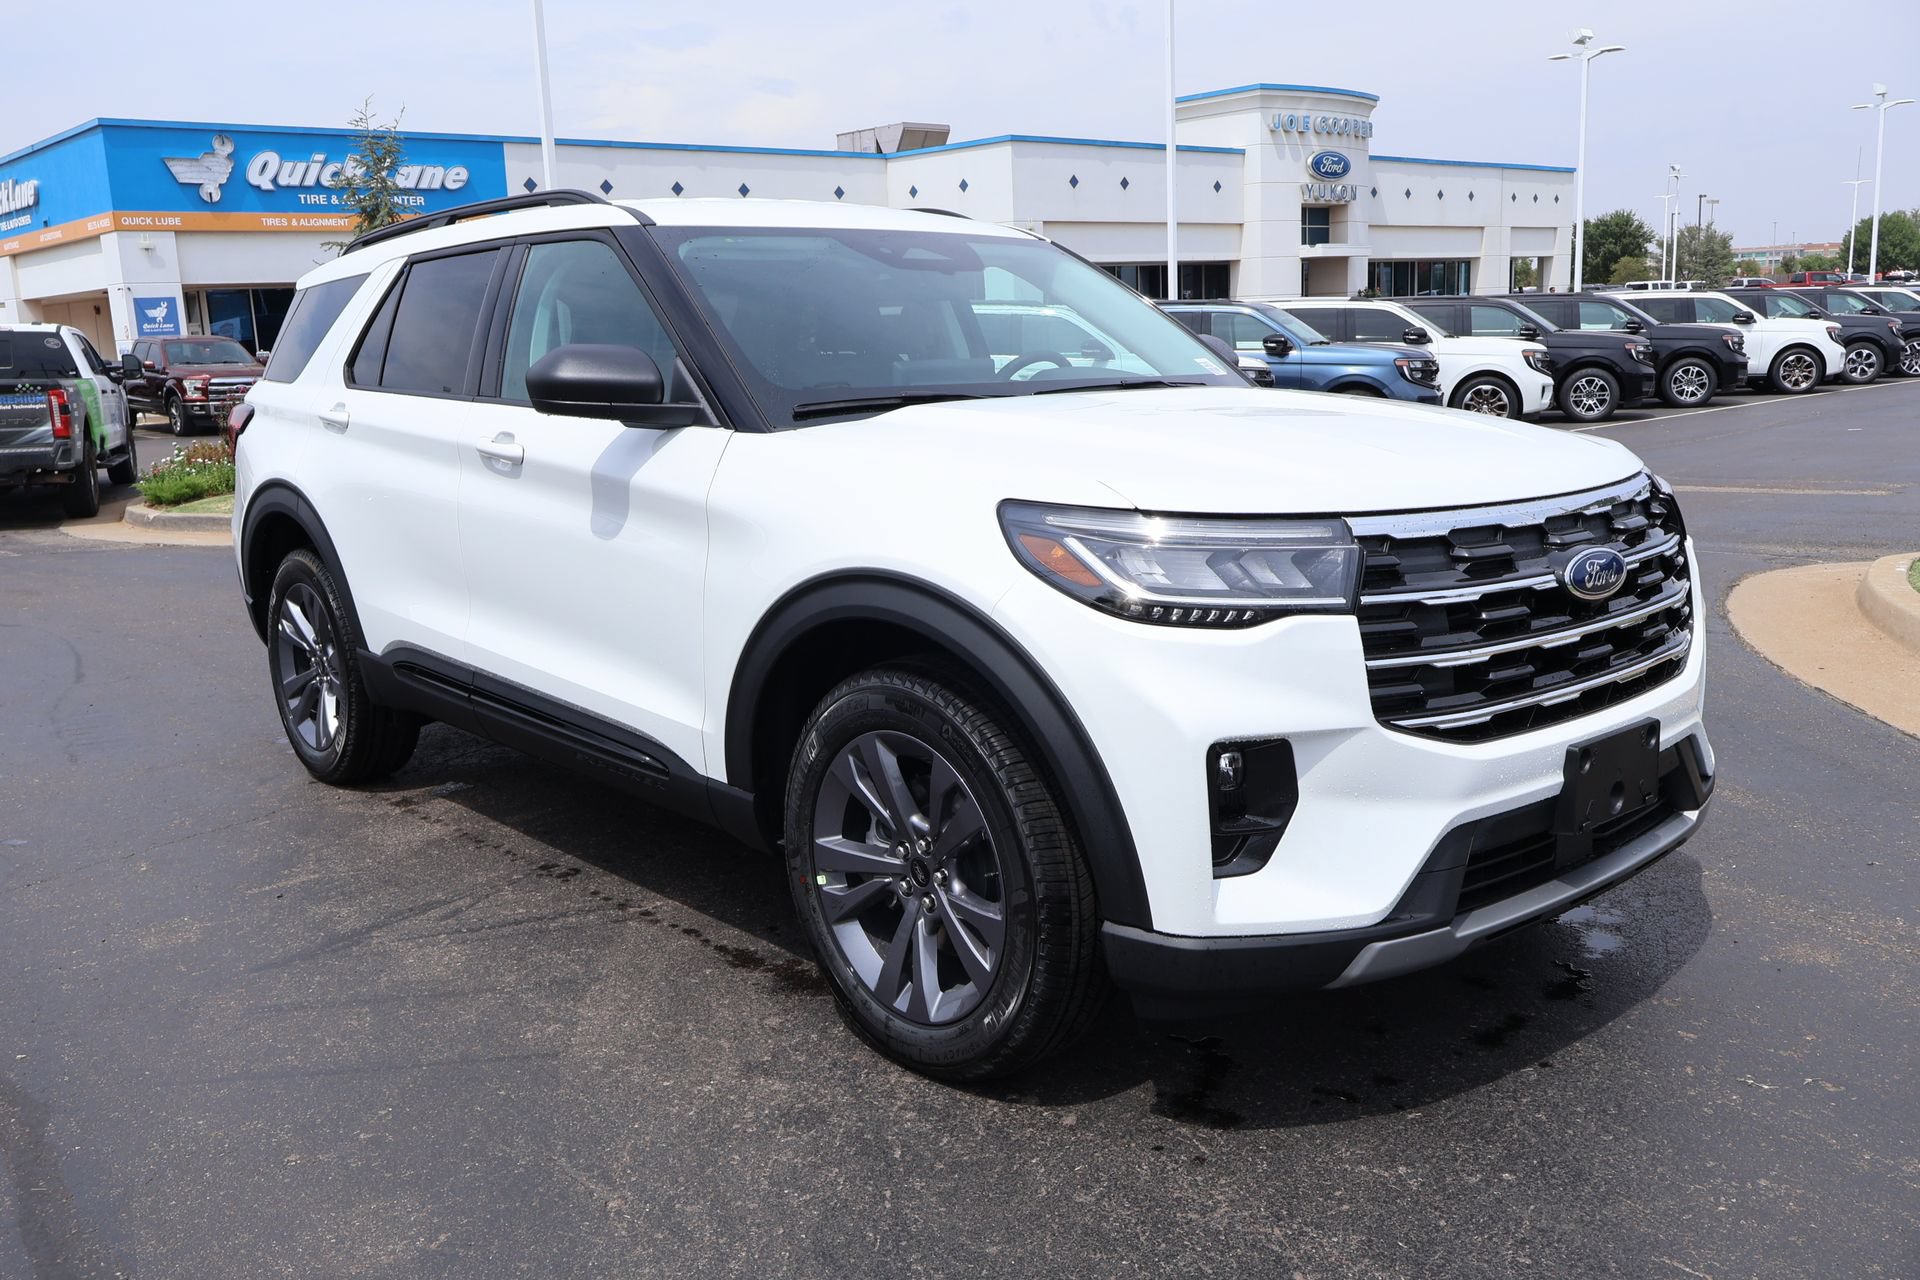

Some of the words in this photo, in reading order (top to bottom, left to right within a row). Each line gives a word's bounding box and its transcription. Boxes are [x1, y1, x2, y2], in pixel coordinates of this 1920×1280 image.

[1271, 113, 1312, 132] JOE
[246, 151, 367, 191] Quick
[372, 156, 469, 190] ane
[1320, 155, 1345, 173] Ford
[299, 194, 327, 205] TIRE
[330, 195, 340, 205] &
[1303, 183, 1358, 202] YUKON
[121, 216, 153, 226] QUICK
[155, 216, 182, 226] LUBE
[261, 217, 288, 226] TIRES
[291, 217, 298, 226] &
[300, 217, 350, 227] ALIGNMENT
[1585, 559, 1618, 589] Ford
